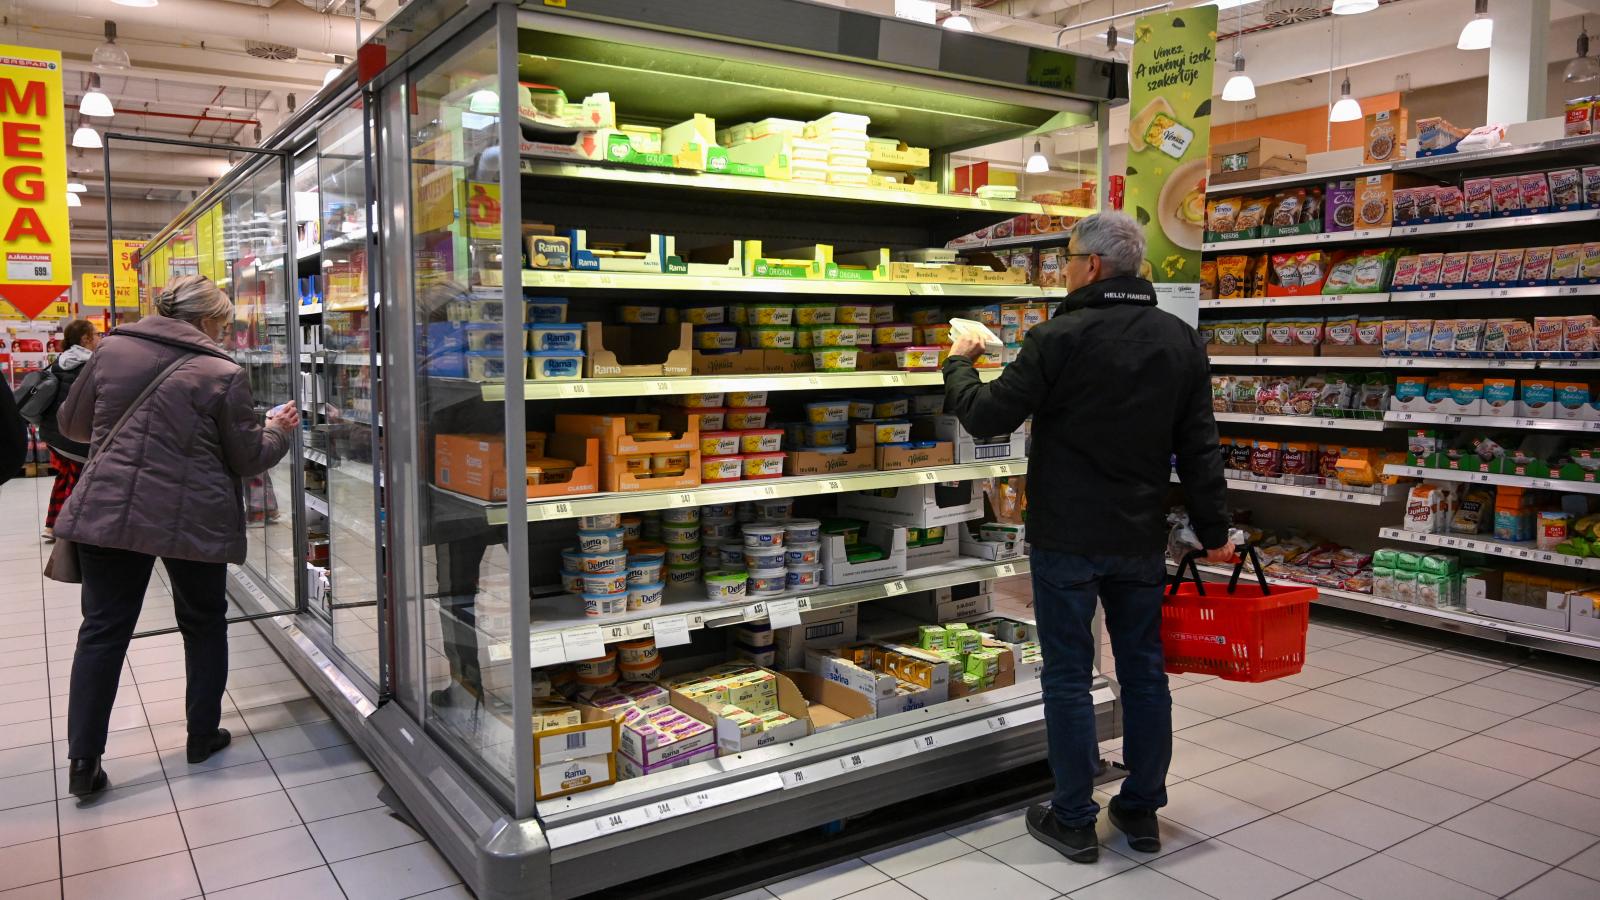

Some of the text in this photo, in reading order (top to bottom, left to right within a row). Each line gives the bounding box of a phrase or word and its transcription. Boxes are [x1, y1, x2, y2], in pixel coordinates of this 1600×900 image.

[1154, 45, 1184, 60] Vénusz
[1135, 63, 1146, 79] A
[0, 77, 51, 243] MEGA
[538, 242, 566, 253] Rama
[578, 259, 598, 267] Rama
[669, 264, 687, 272] Rama
[34, 266, 47, 276] 699
[1127, 293, 1150, 301] HANSEN
[547, 333, 570, 342] Rama
[549, 360, 572, 368] Rama
[594, 365, 621, 374] Rama
[1409, 507, 1429, 515] JUMBO
[583, 538, 602, 548] elma
[588, 559, 614, 571] Delma
[726, 581, 746, 593] Delm
[641, 591, 661, 602] Delm
[612, 628, 622, 637] 472
[757, 736, 775, 746] Rama
[662, 748, 680, 759] Rama
[565, 768, 587, 779] Rama
[658, 803, 671, 814] 344
[608, 816, 623, 827] 344
